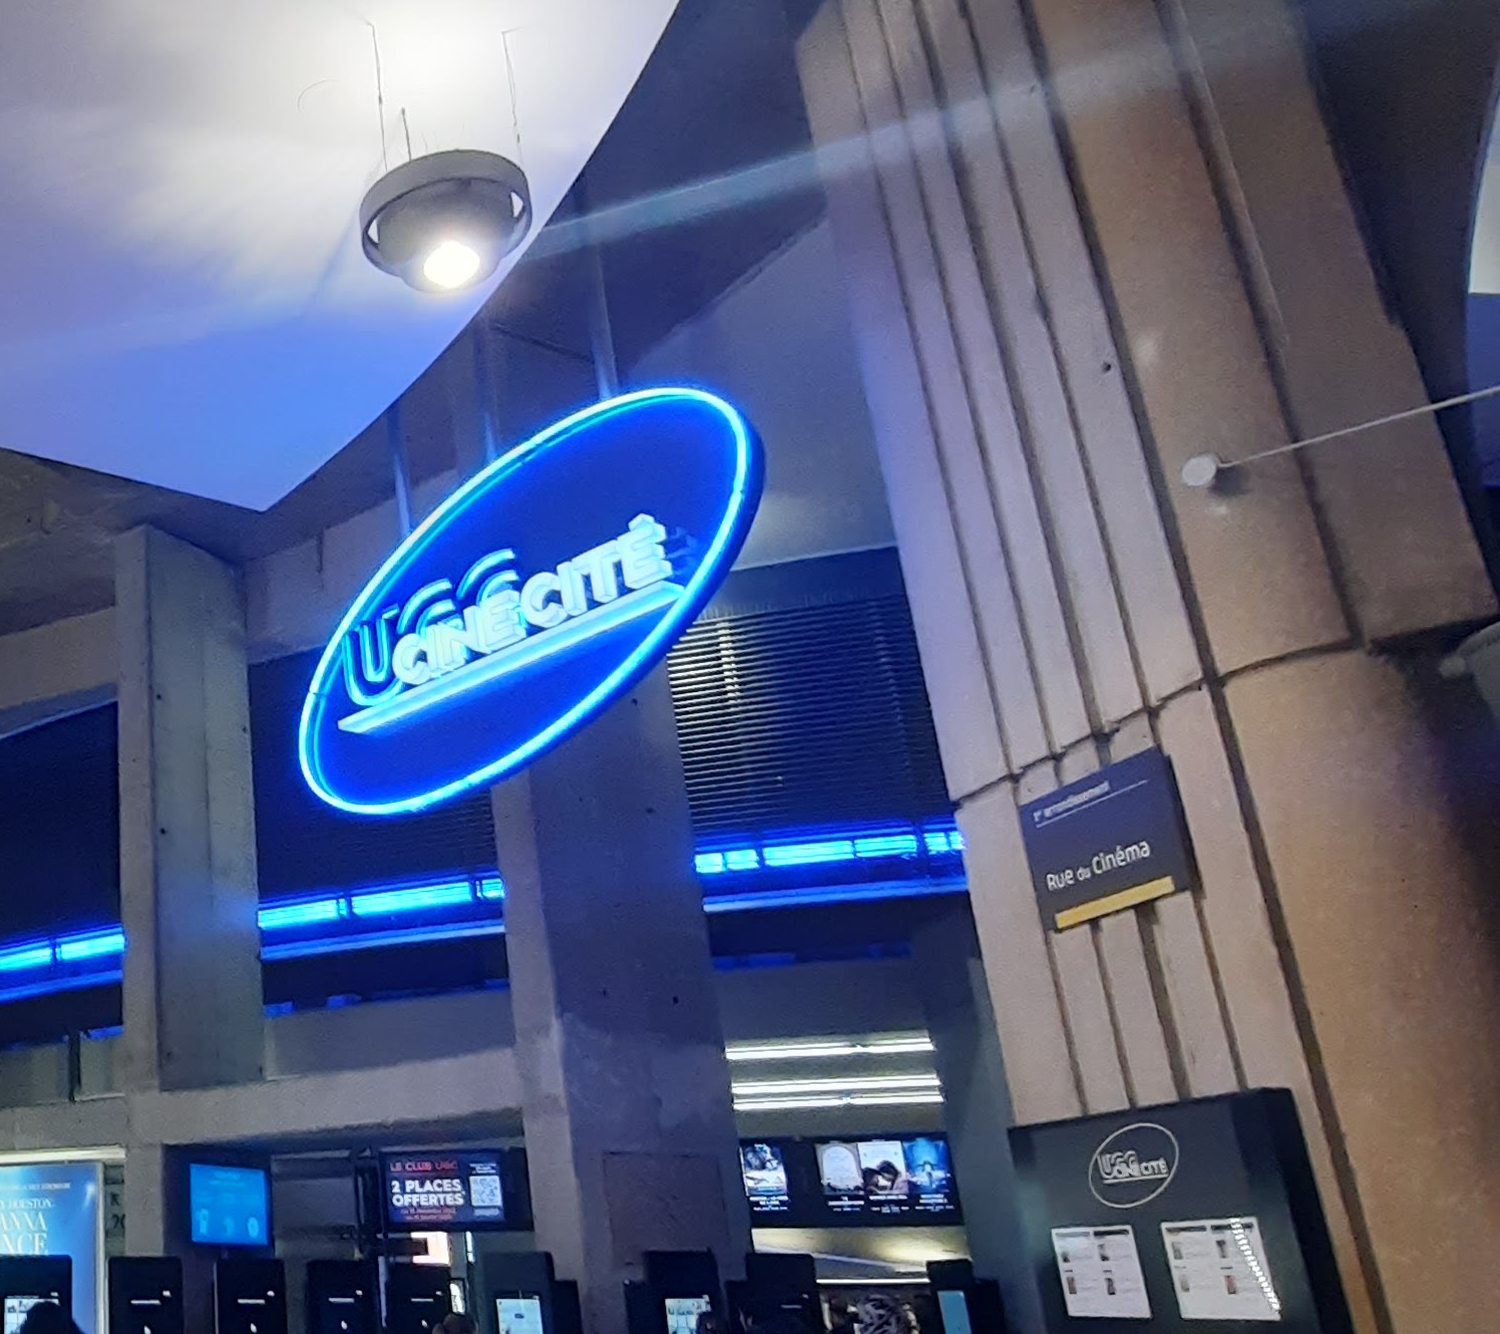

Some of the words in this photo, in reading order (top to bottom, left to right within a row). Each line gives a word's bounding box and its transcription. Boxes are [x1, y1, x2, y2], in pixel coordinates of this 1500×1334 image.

[1046, 869, 1075, 891] Rue
[1077, 866, 1092, 881] du
[1092, 841, 1151, 875] Cinéma
[404, 1160, 432, 1172] CLUB
[391, 1179, 401, 1194] 2
[404, 1178, 462, 1194] PLACES
